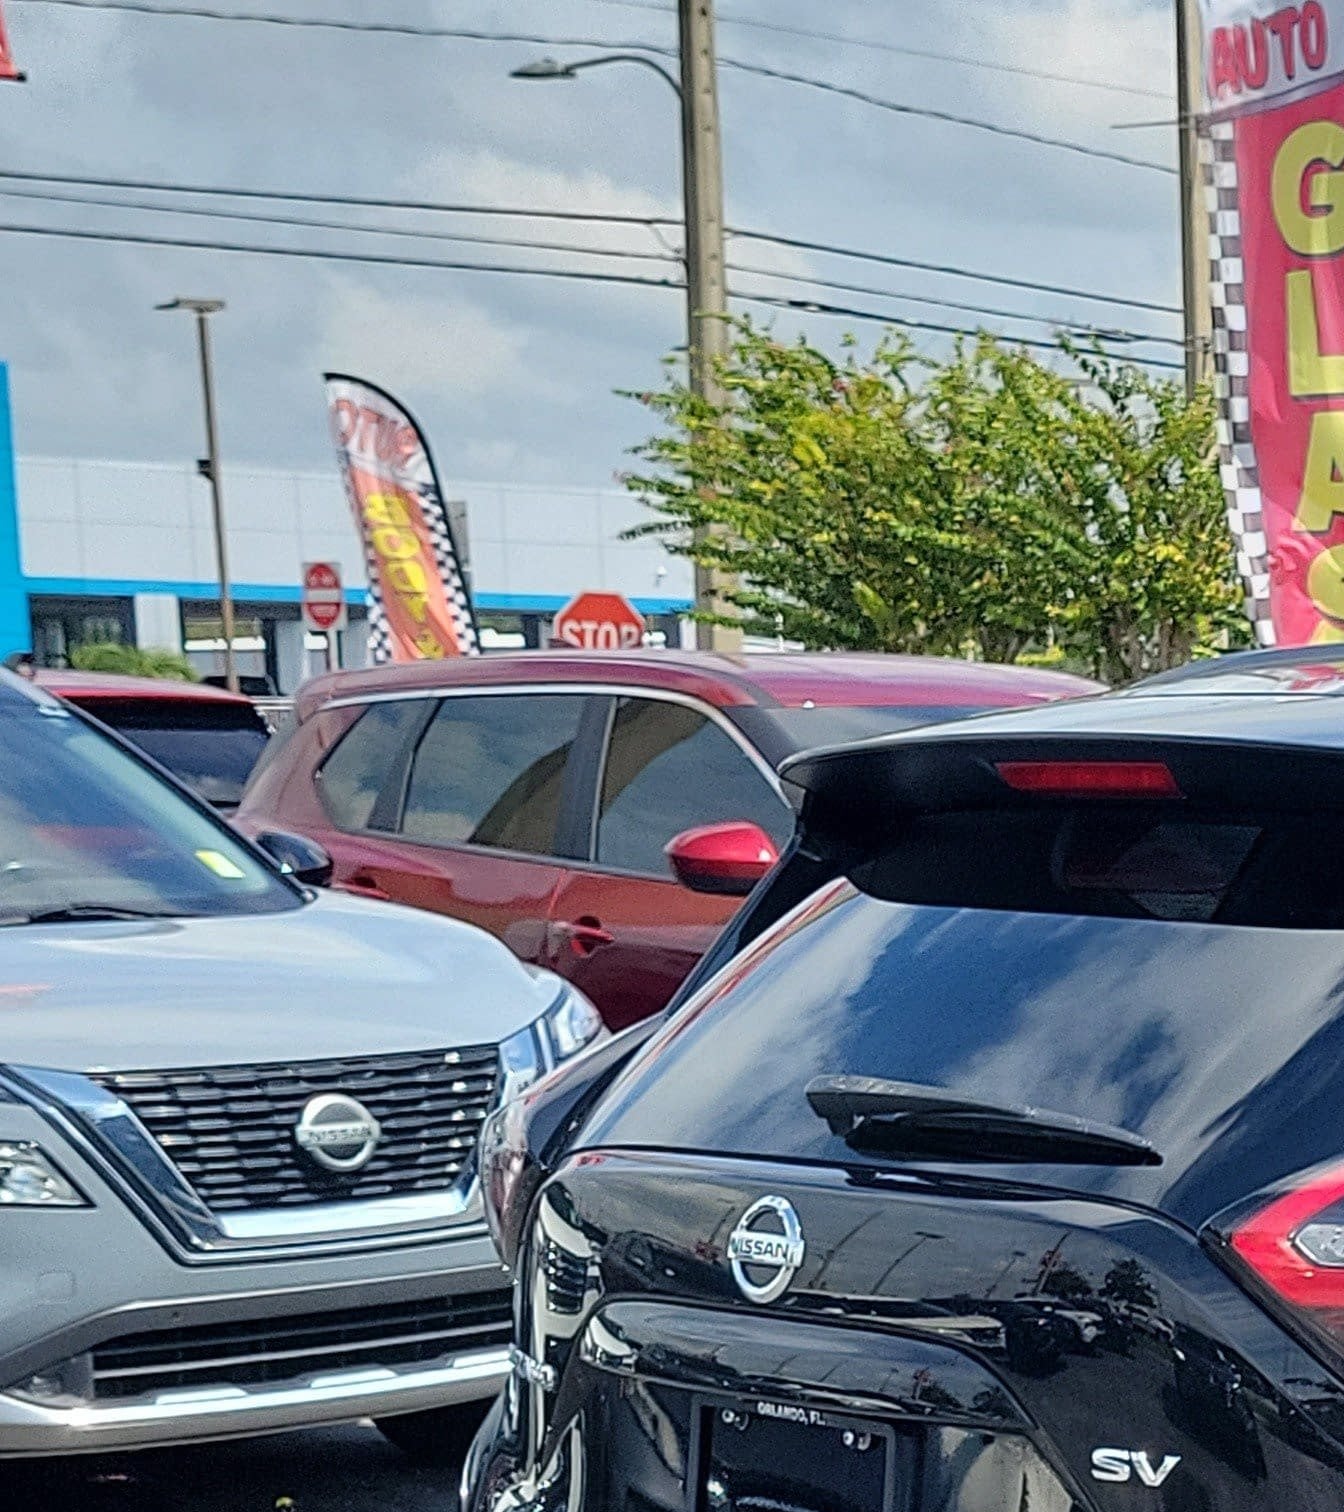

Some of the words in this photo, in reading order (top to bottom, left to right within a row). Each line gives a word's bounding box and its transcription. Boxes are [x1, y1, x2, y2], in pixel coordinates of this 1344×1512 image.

[1207, 0, 1328, 101] AUTO
[561, 618, 641, 650] STOP
[730, 1236, 790, 1262] NISSAN
[757, 1401, 809, 1426] ORLANDO,
[1090, 1447, 1182, 1487] SV
